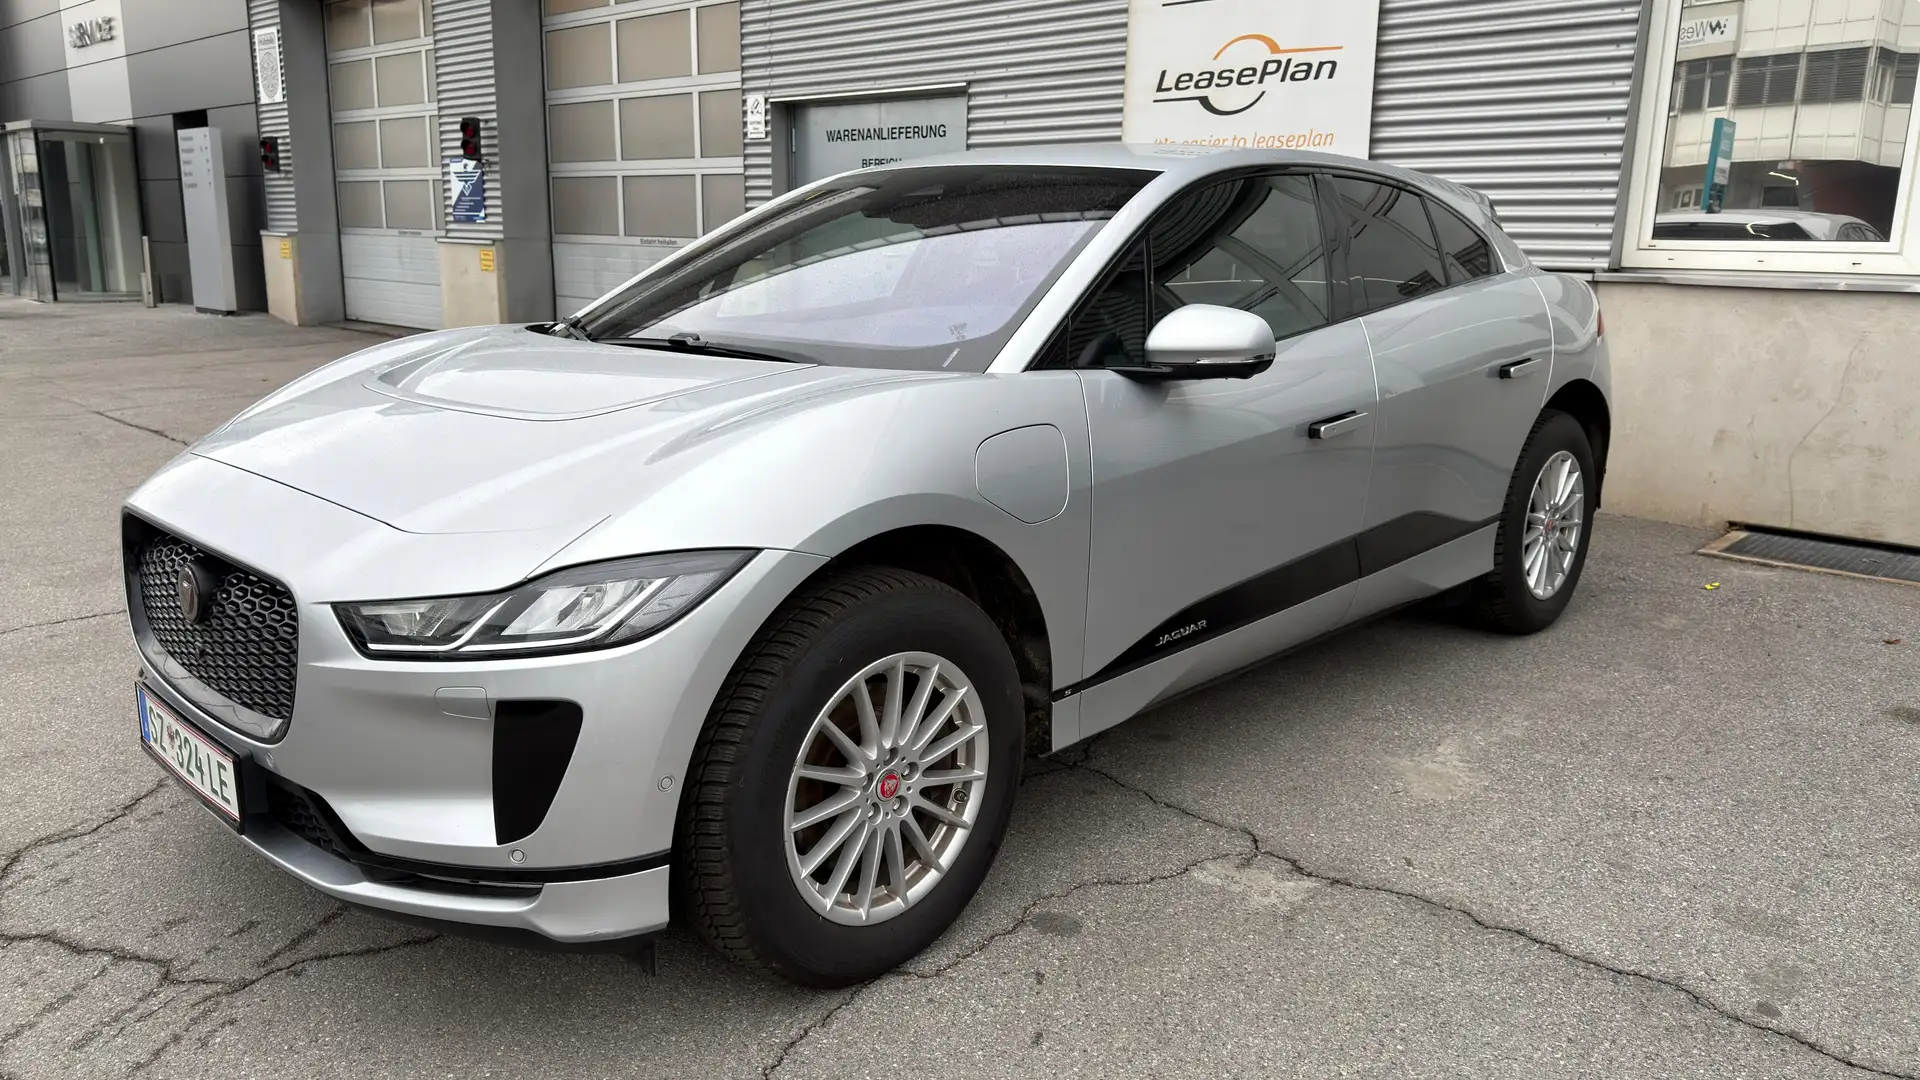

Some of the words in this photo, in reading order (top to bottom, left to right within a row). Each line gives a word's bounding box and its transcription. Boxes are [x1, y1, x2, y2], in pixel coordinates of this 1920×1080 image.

[1156, 58, 1337, 93] LeasePlan
[826, 124, 947, 142] WARENANLIEFERUNG
[1232, 134, 1247, 148] to
[1252, 127, 1335, 150] leaseplan
[862, 158, 902, 168] BEREI
[1155, 620, 1207, 646] JAGUAR
[149, 705, 167, 754] SZ
